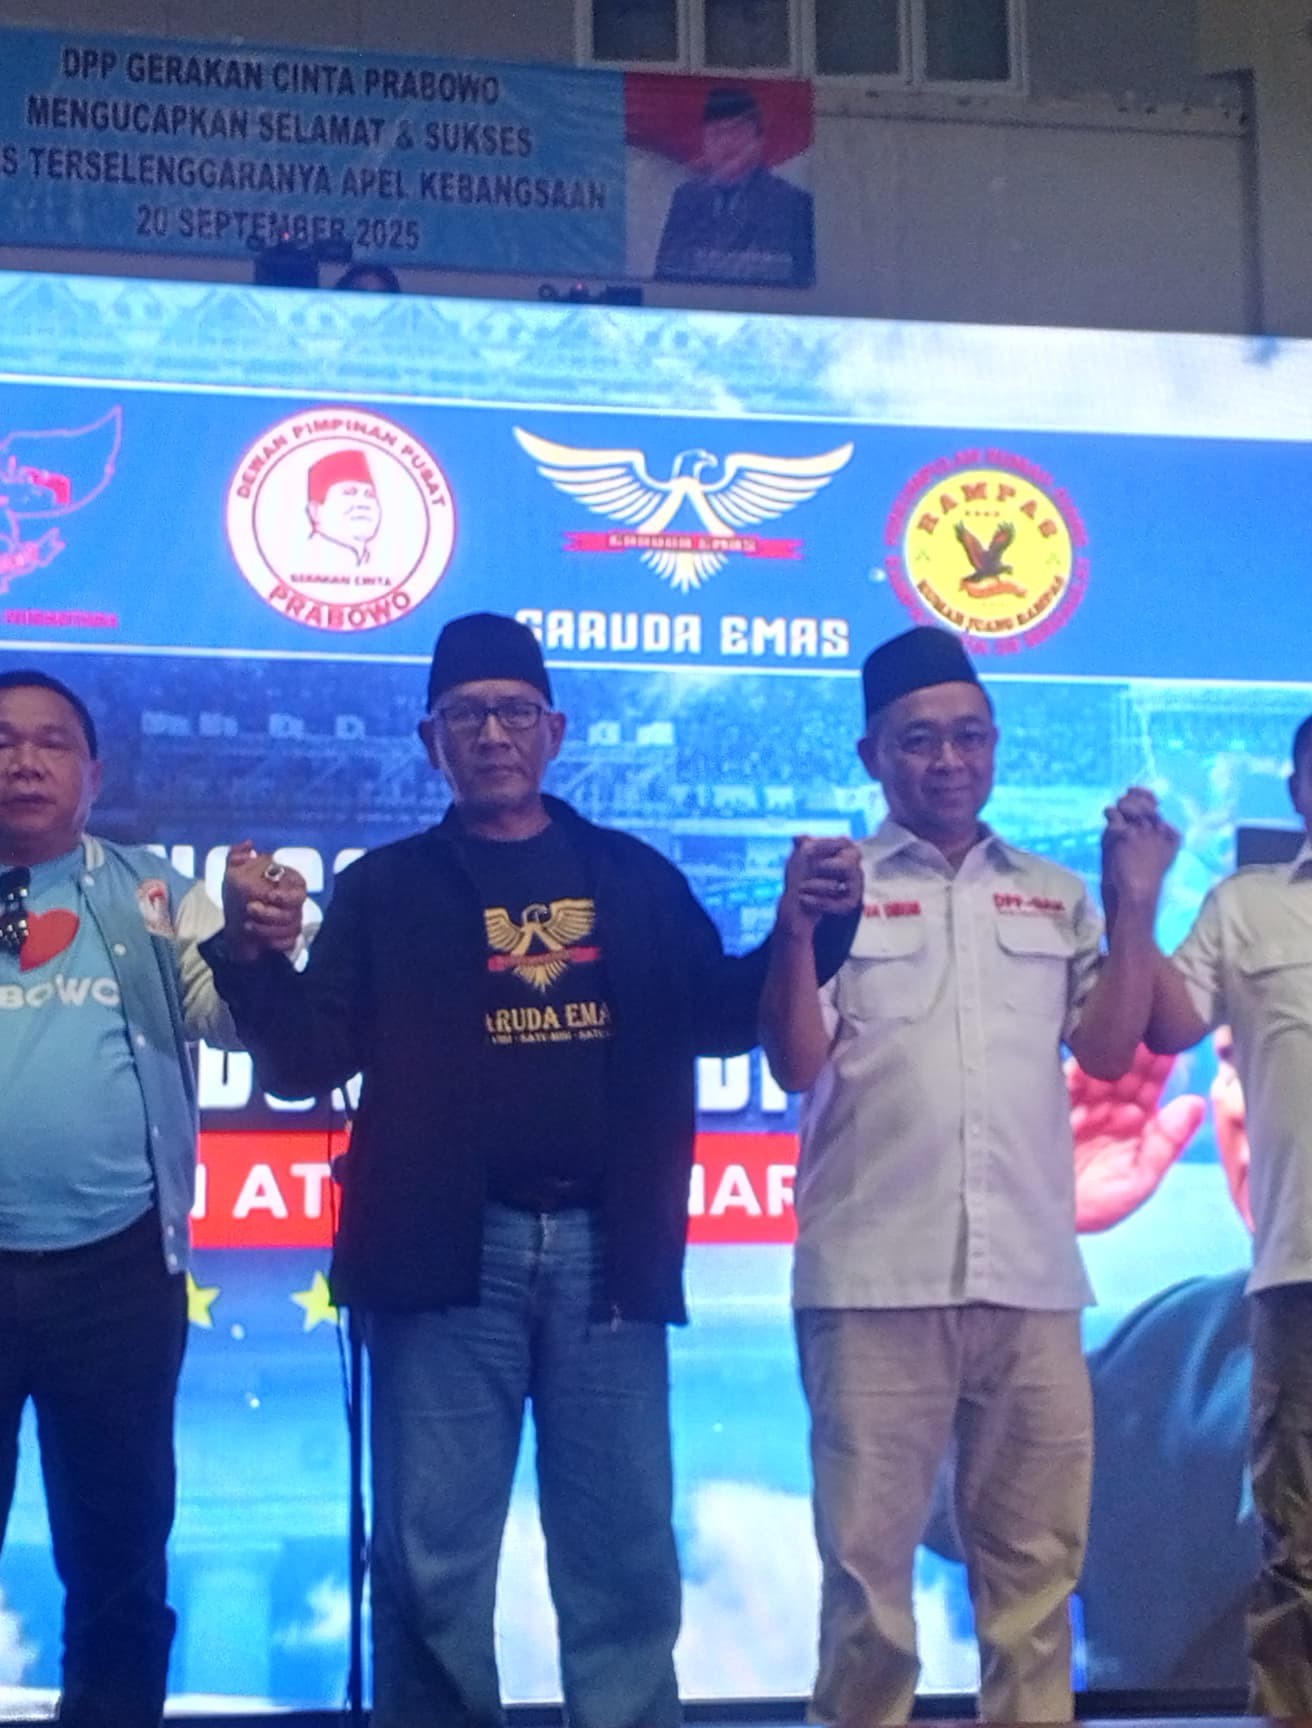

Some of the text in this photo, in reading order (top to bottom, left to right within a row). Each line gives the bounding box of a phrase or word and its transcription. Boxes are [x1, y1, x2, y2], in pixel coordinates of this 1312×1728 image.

[62, 48, 501, 105] DPP GERAKAN CINTA PRABOWO
[25, 94, 533, 158] MENGUCAPKAN SELAMAT & SUKSES
[28, 147, 332, 196] TERSELENGGARANYA
[341, 166, 409, 199] APEL
[420, 170, 607, 210] KEBANGSAAN
[137, 203, 168, 237] 20
[355, 218, 421, 251] 2025
[236, 418, 446, 507] DEWAN PIMPINAN PUSAT
[268, 585, 412, 629] PRABOWO
[515, 608, 851, 659] GARUDA EMAS
